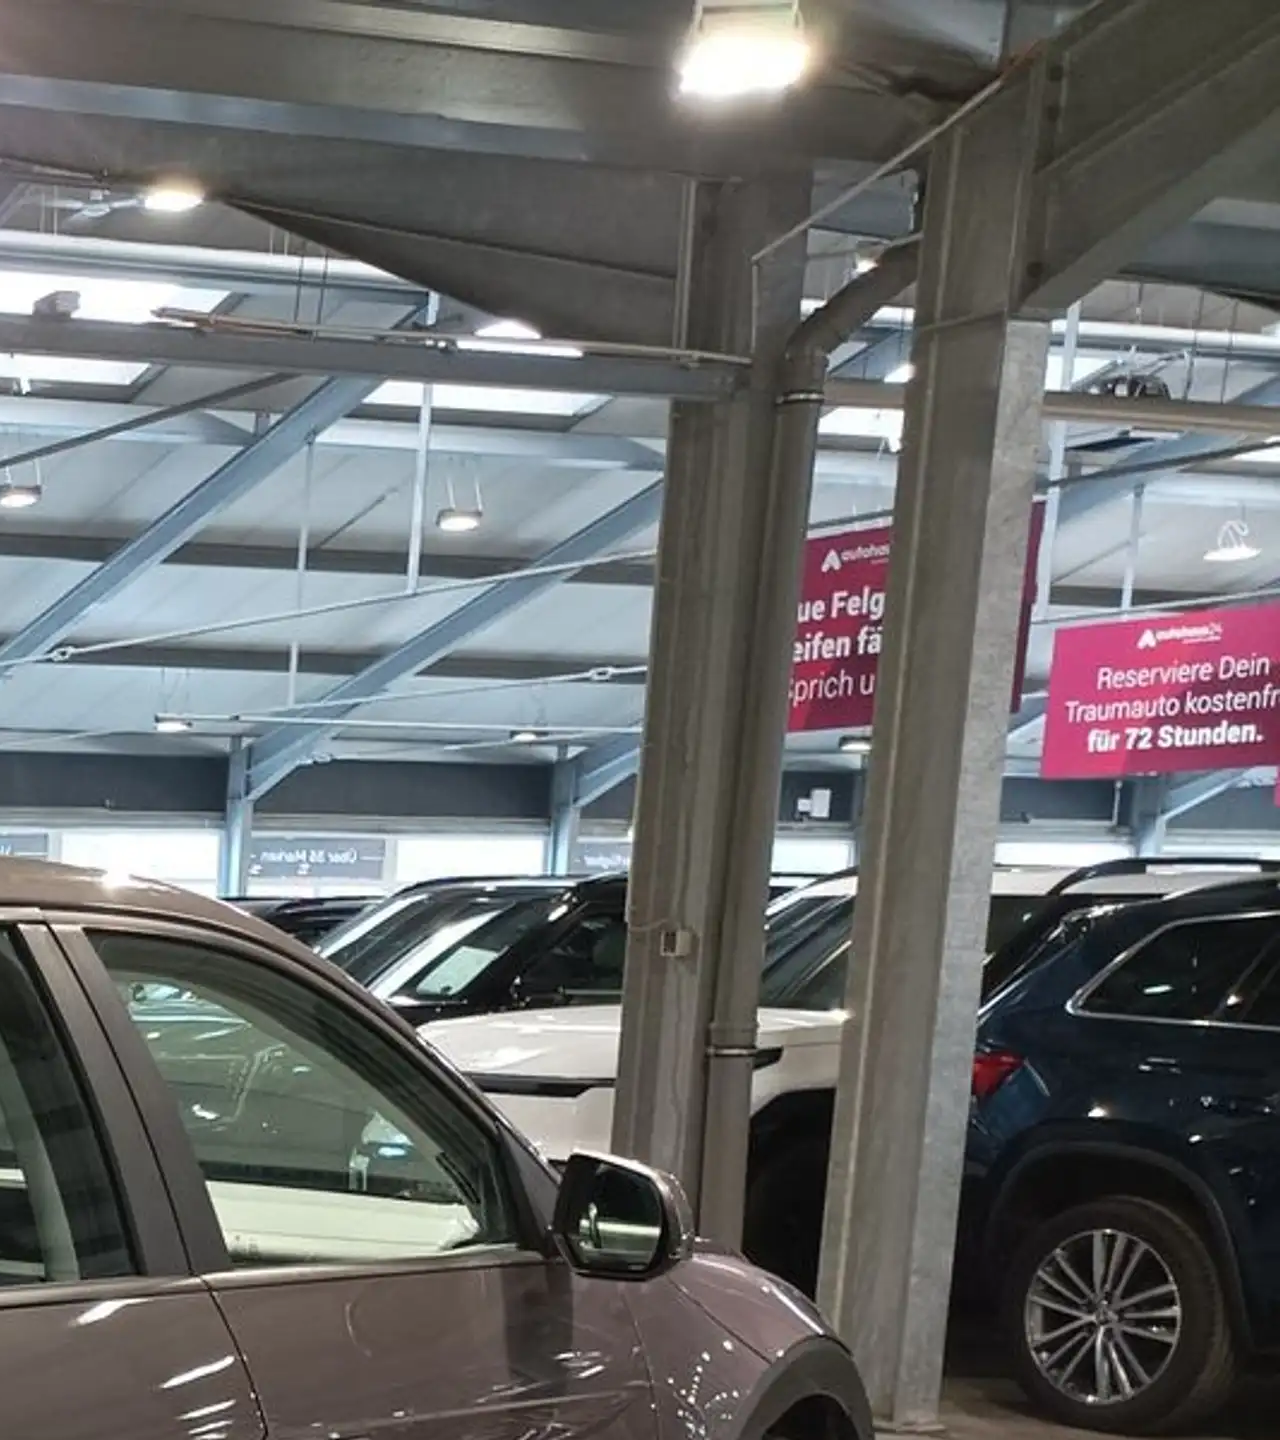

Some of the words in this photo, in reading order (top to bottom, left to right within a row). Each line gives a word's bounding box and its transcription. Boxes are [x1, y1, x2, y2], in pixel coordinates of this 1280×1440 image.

[797, 602, 826, 624] ue
[831, 585, 886, 620] Felg
[792, 632, 851, 664] eifen
[857, 625, 883, 655] fä
[1096, 659, 1214, 691] Reserviere
[1218, 652, 1271, 680] Dein
[1064, 700, 1181, 724] Traumauto
[1184, 683, 1280, 715] kostenfr
[1087, 727, 1120, 752] für
[1125, 726, 1153, 750] 72
[1158, 720, 1265, 749] Stunden.
